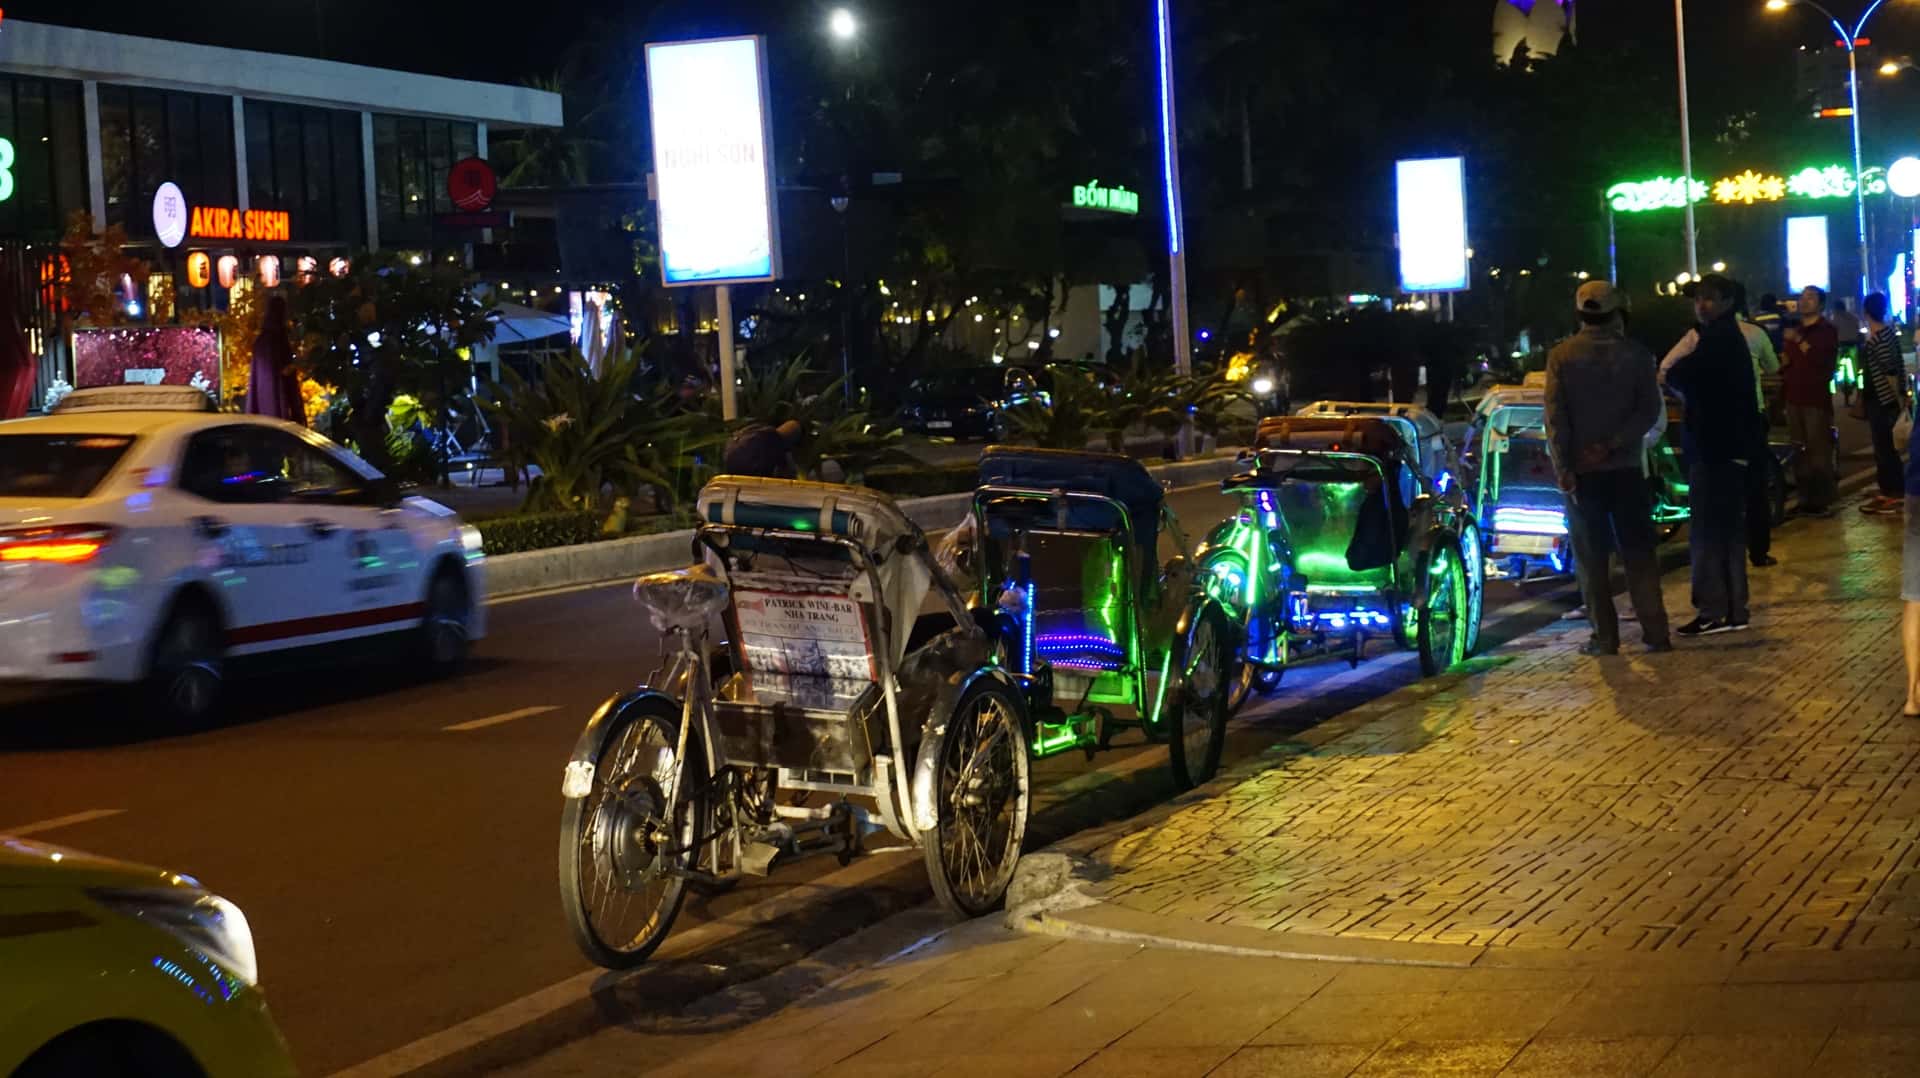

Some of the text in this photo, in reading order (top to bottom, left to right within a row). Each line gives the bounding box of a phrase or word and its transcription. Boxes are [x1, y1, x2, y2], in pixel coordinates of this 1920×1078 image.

[190, 205, 243, 238] AKIRA
[244, 209, 289, 241] SUSHI
[764, 598, 806, 609] PATRICK
[784, 609, 839, 622] NHA TRANG
